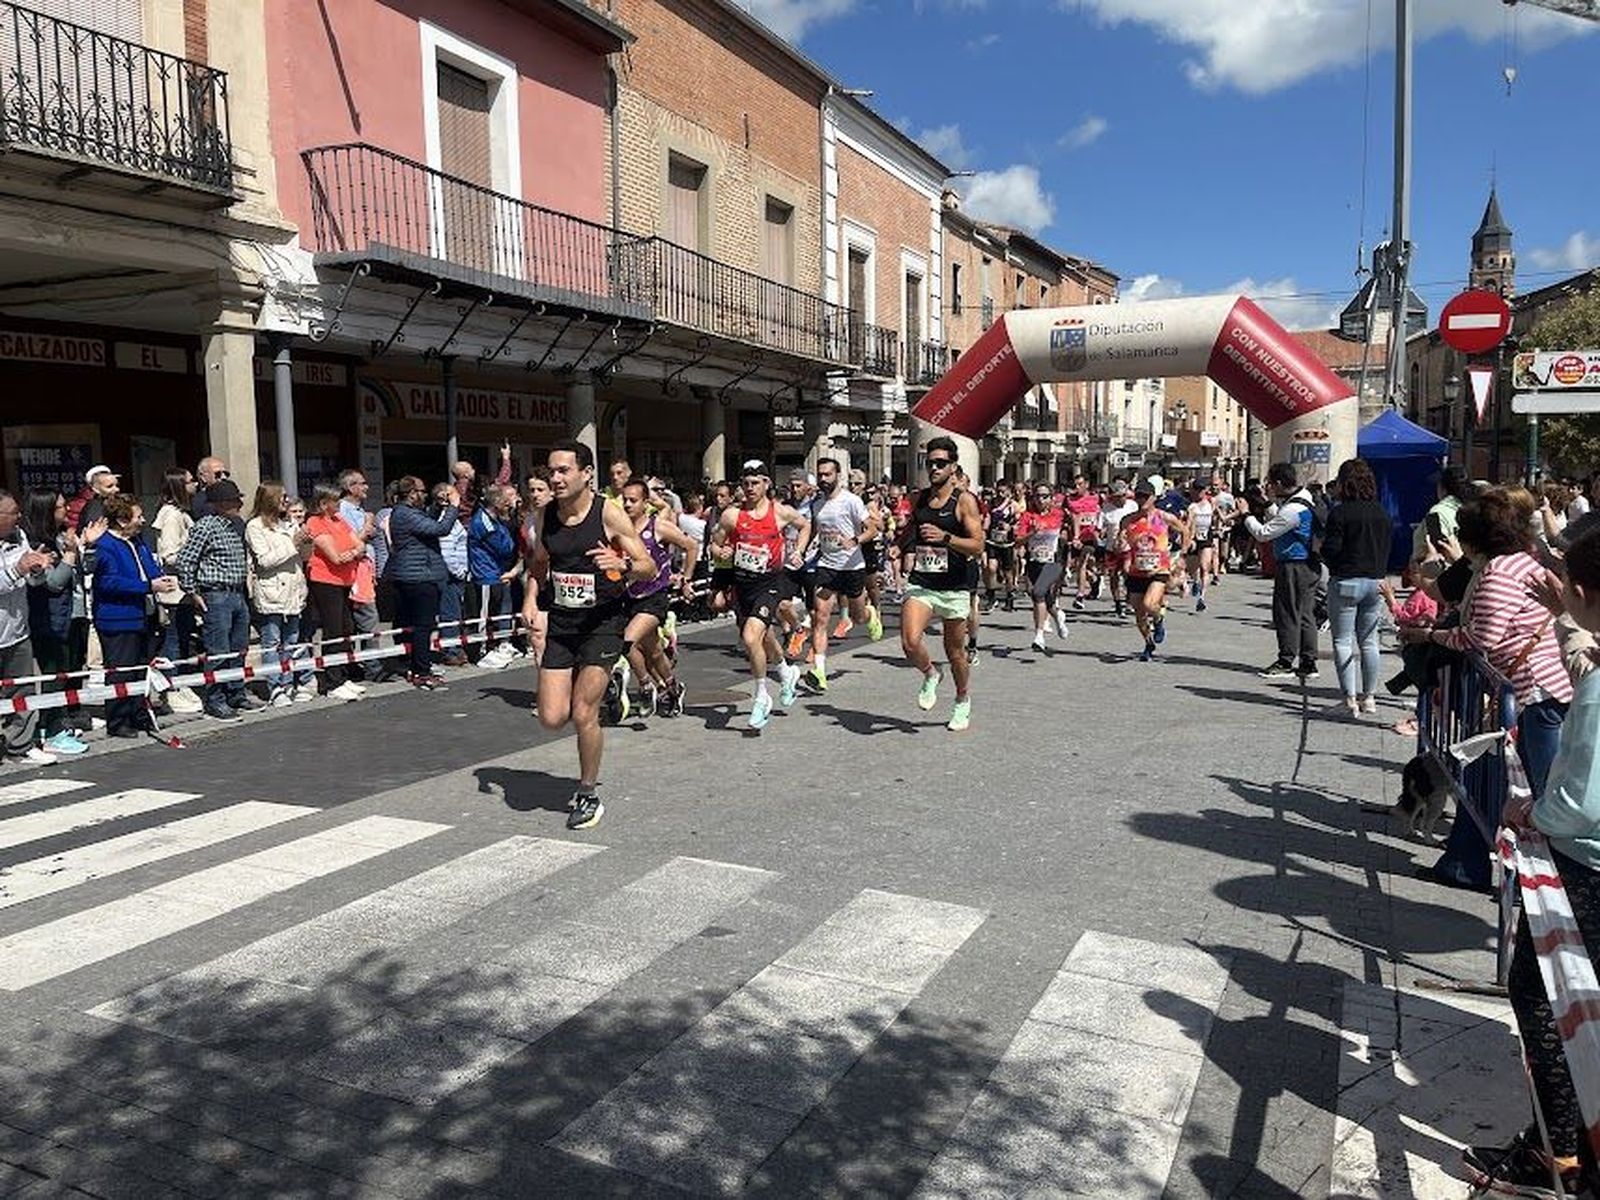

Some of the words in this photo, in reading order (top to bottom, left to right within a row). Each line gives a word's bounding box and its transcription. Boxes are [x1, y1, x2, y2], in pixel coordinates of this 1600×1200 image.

[0, 333, 105, 363] CALZADOS
[141, 347, 162, 369] EL
[1105, 346, 1179, 360] Salamanca
[1231, 327, 1258, 351] CON
[1256, 348, 1317, 403] NUESTROS
[305, 362, 333, 385] IRIS
[931, 402, 954, 424] CON
[953, 391, 968, 405] EL
[966, 343, 1013, 391] DEPORTE
[1223, 343, 1298, 410] DEPORTISTAS
[410, 388, 500, 419] CALADOS
[507, 397, 526, 420] EL
[21, 449, 62, 465] VENDE
